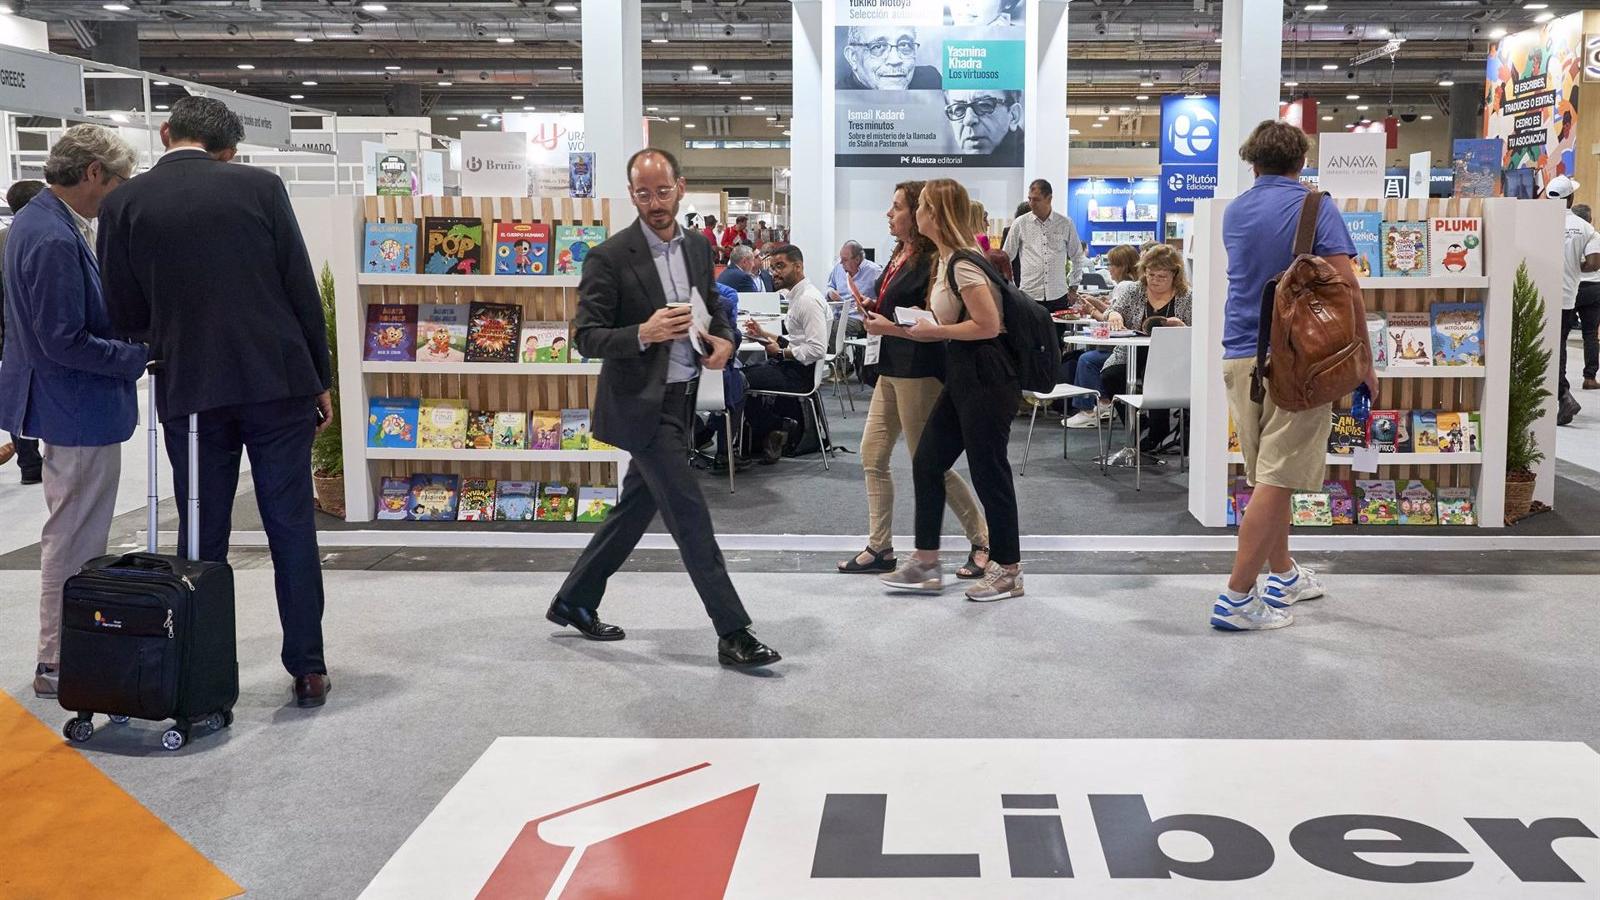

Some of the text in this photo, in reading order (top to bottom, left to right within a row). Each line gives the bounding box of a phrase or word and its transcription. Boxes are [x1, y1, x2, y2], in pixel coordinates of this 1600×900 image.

[850, 9, 888, 19] Selección
[948, 46, 986, 57] Yasmina
[949, 58, 982, 68] Khadra
[1, 69, 26, 88] GREECE
[949, 69, 999, 79] Los virtuosos
[1514, 78, 1545, 94] SI ESCRIBES,
[1504, 100, 1529, 113] TRADUCES
[1530, 99, 1535, 107] O
[876, 110, 904, 120] Kadaré
[849, 121, 894, 130] Tres minutos
[1516, 116, 1540, 129] CEDRO ES
[1509, 132, 1546, 147] TU ASOCIACIÓN
[486, 160, 522, 170] Bruño
[1328, 155, 1378, 168] ANAYA
[1186, 174, 1216, 184] Plutón
[1347, 220, 1364, 232] 101
[1435, 220, 1477, 232] PLUMI
[429, 230, 475, 259] POP
[1389, 319, 1428, 328] prehistoria
[810, 793, 1598, 884] Liber
